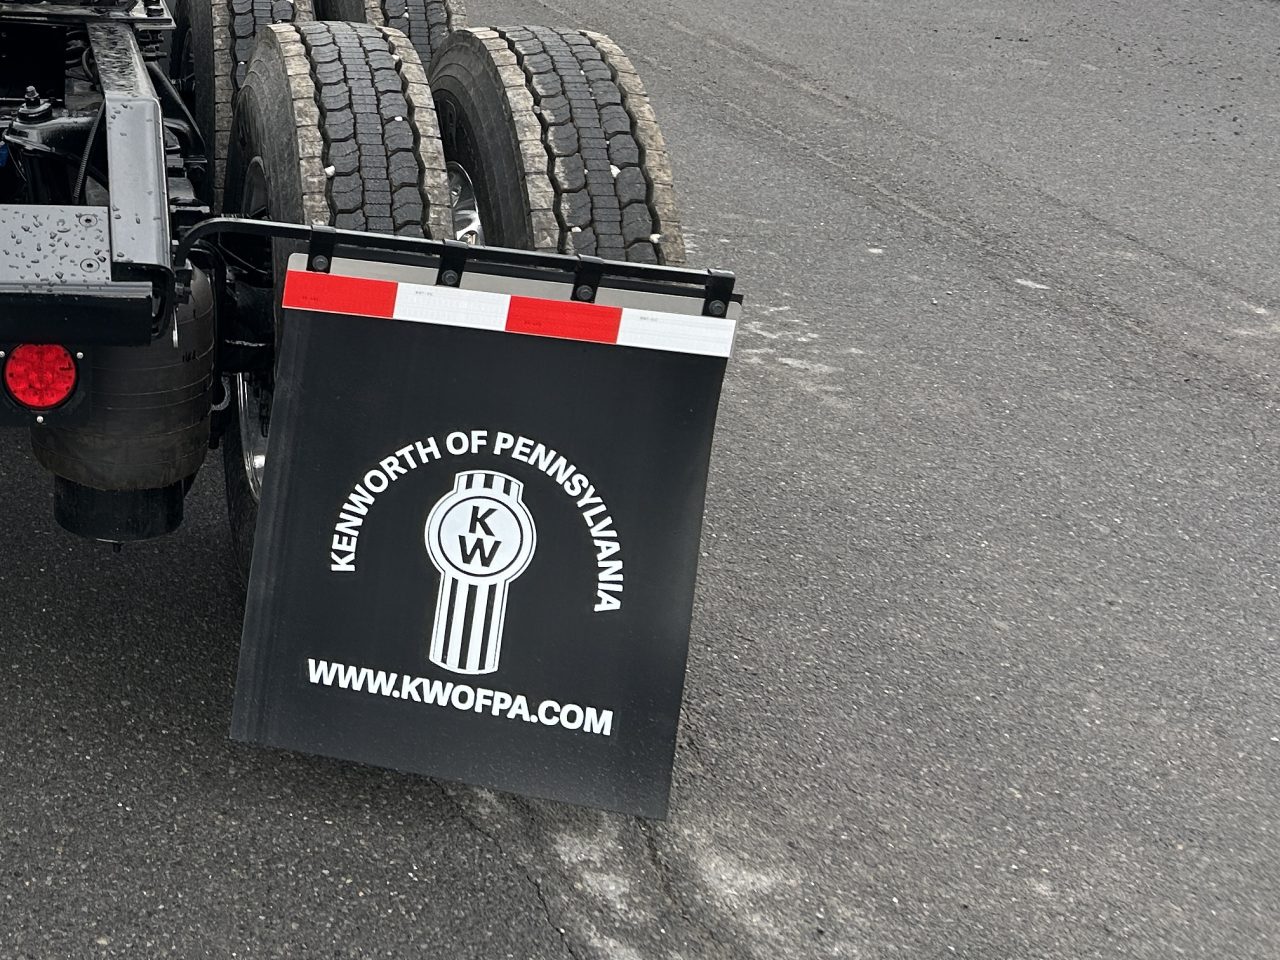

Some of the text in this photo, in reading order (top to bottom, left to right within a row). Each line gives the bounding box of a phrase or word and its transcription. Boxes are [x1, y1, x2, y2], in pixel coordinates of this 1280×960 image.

[330, 430, 624, 613] KENWORTH OF PENNSYLVANIA
[307, 657, 614, 737] WWW.KWOFPA.COM
